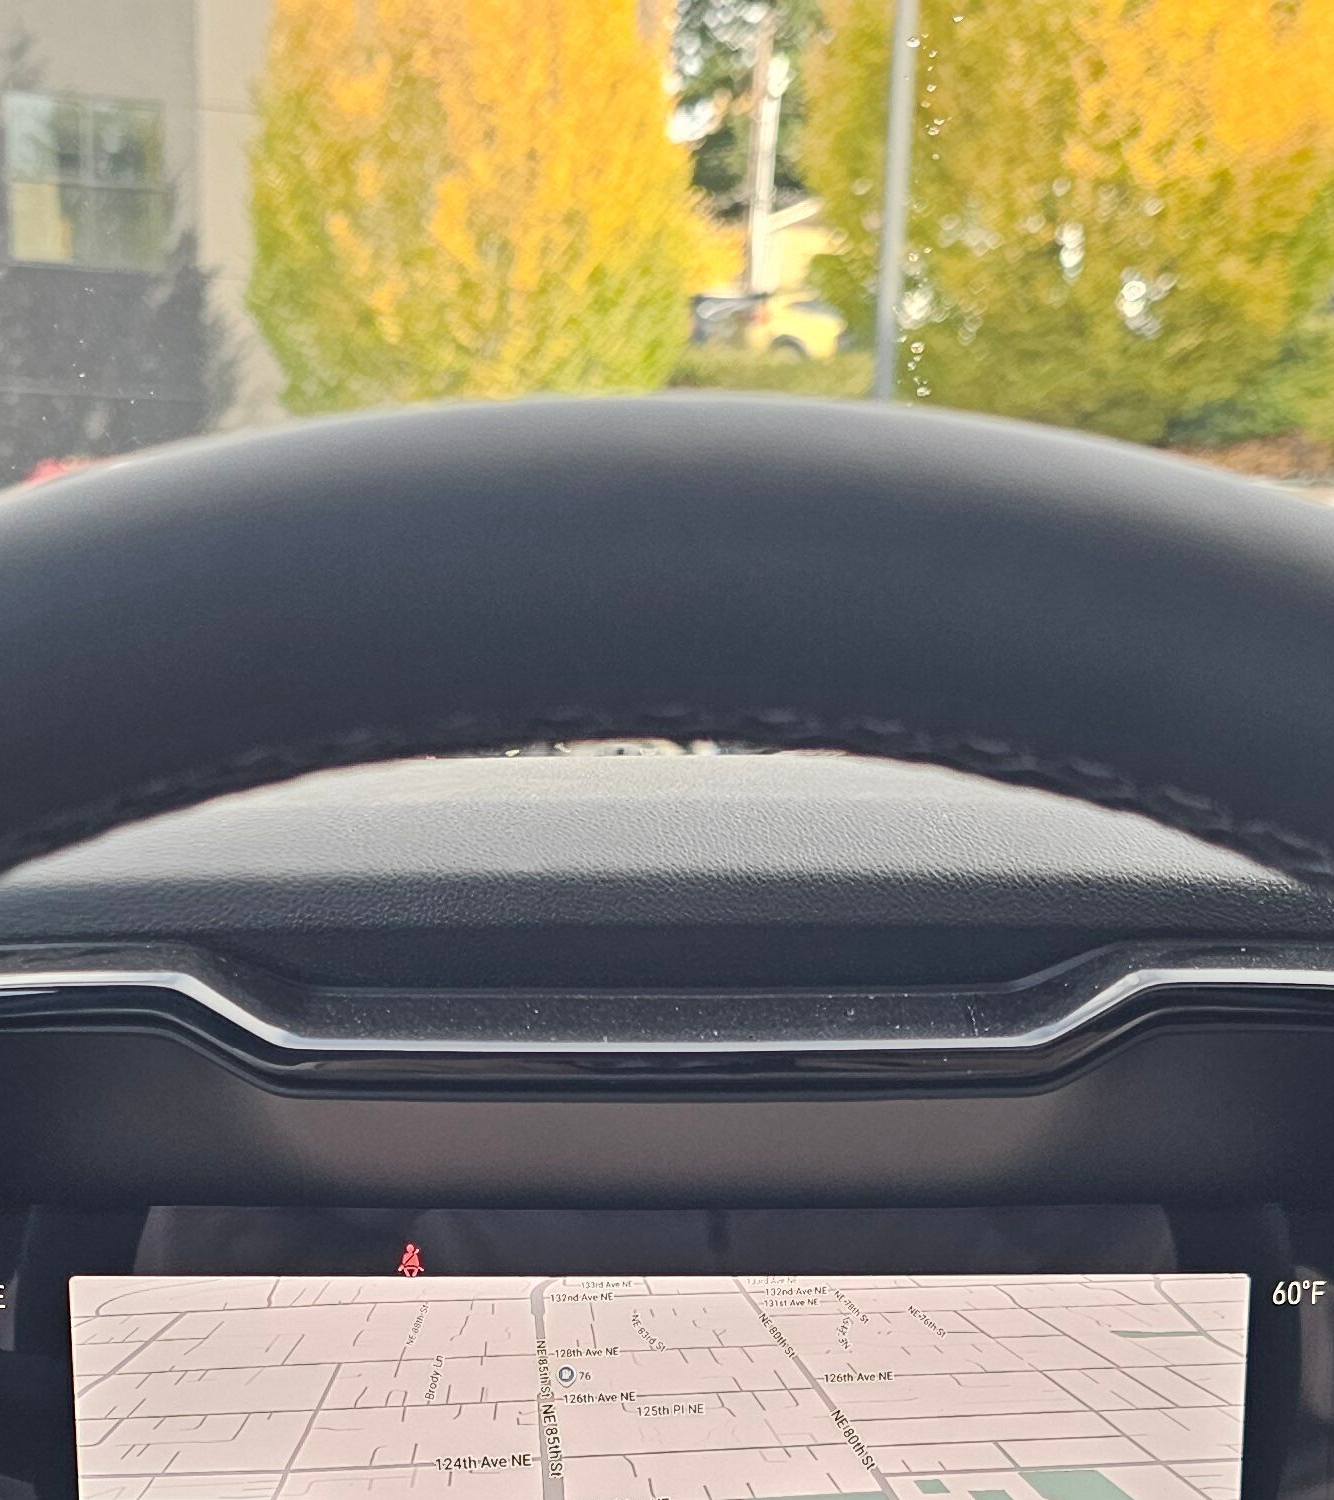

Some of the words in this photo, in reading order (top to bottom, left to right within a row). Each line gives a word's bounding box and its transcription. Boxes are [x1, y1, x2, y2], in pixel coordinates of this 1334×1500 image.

[581, 1293, 599, 1302] Ave
[600, 1292, 614, 1301] NE
[796, 1287, 812, 1296] Ave
[814, 1286, 827, 1295] NE
[1272, 1280, 1327, 1305] 60°F
[789, 1299, 805, 1307] Ave
[807, 1298, 818, 1306] NE
[759, 1313, 771, 1328] NE
[769, 1326, 787, 1348] 80th
[784, 1344, 796, 1358] St
[536, 1340, 547, 1356] NE
[555, 1348, 582, 1358] 128th
[586, 1348, 603, 1357] Ave
[605, 1347, 619, 1356] NE
[538, 1357, 551, 1384] 85th
[578, 1371, 591, 1381] 76
[824, 1373, 853, 1383] 126th
[856, 1373, 875, 1382] Ave
[878, 1371, 893, 1381] NE
[424, 1372, 443, 1401] Brody
[540, 1386, 551, 1400] St
[563, 1394, 595, 1404] 126th
[598, 1393, 618, 1402] Ave
[620, 1392, 636, 1402] NE
[541, 1404, 557, 1424] NE
[636, 1406, 669, 1417] 125th
[688, 1403, 705, 1414] NE
[545, 1427, 562, 1459] 85th
[831, 1409, 848, 1429] NE
[843, 1428, 867, 1457] 80th
[861, 1456, 876, 1471] St
[435, 1457, 477, 1471] 124th
[480, 1457, 508, 1469] Ave
[511, 1454, 533, 1467] NE
[550, 1462, 564, 1477] St
